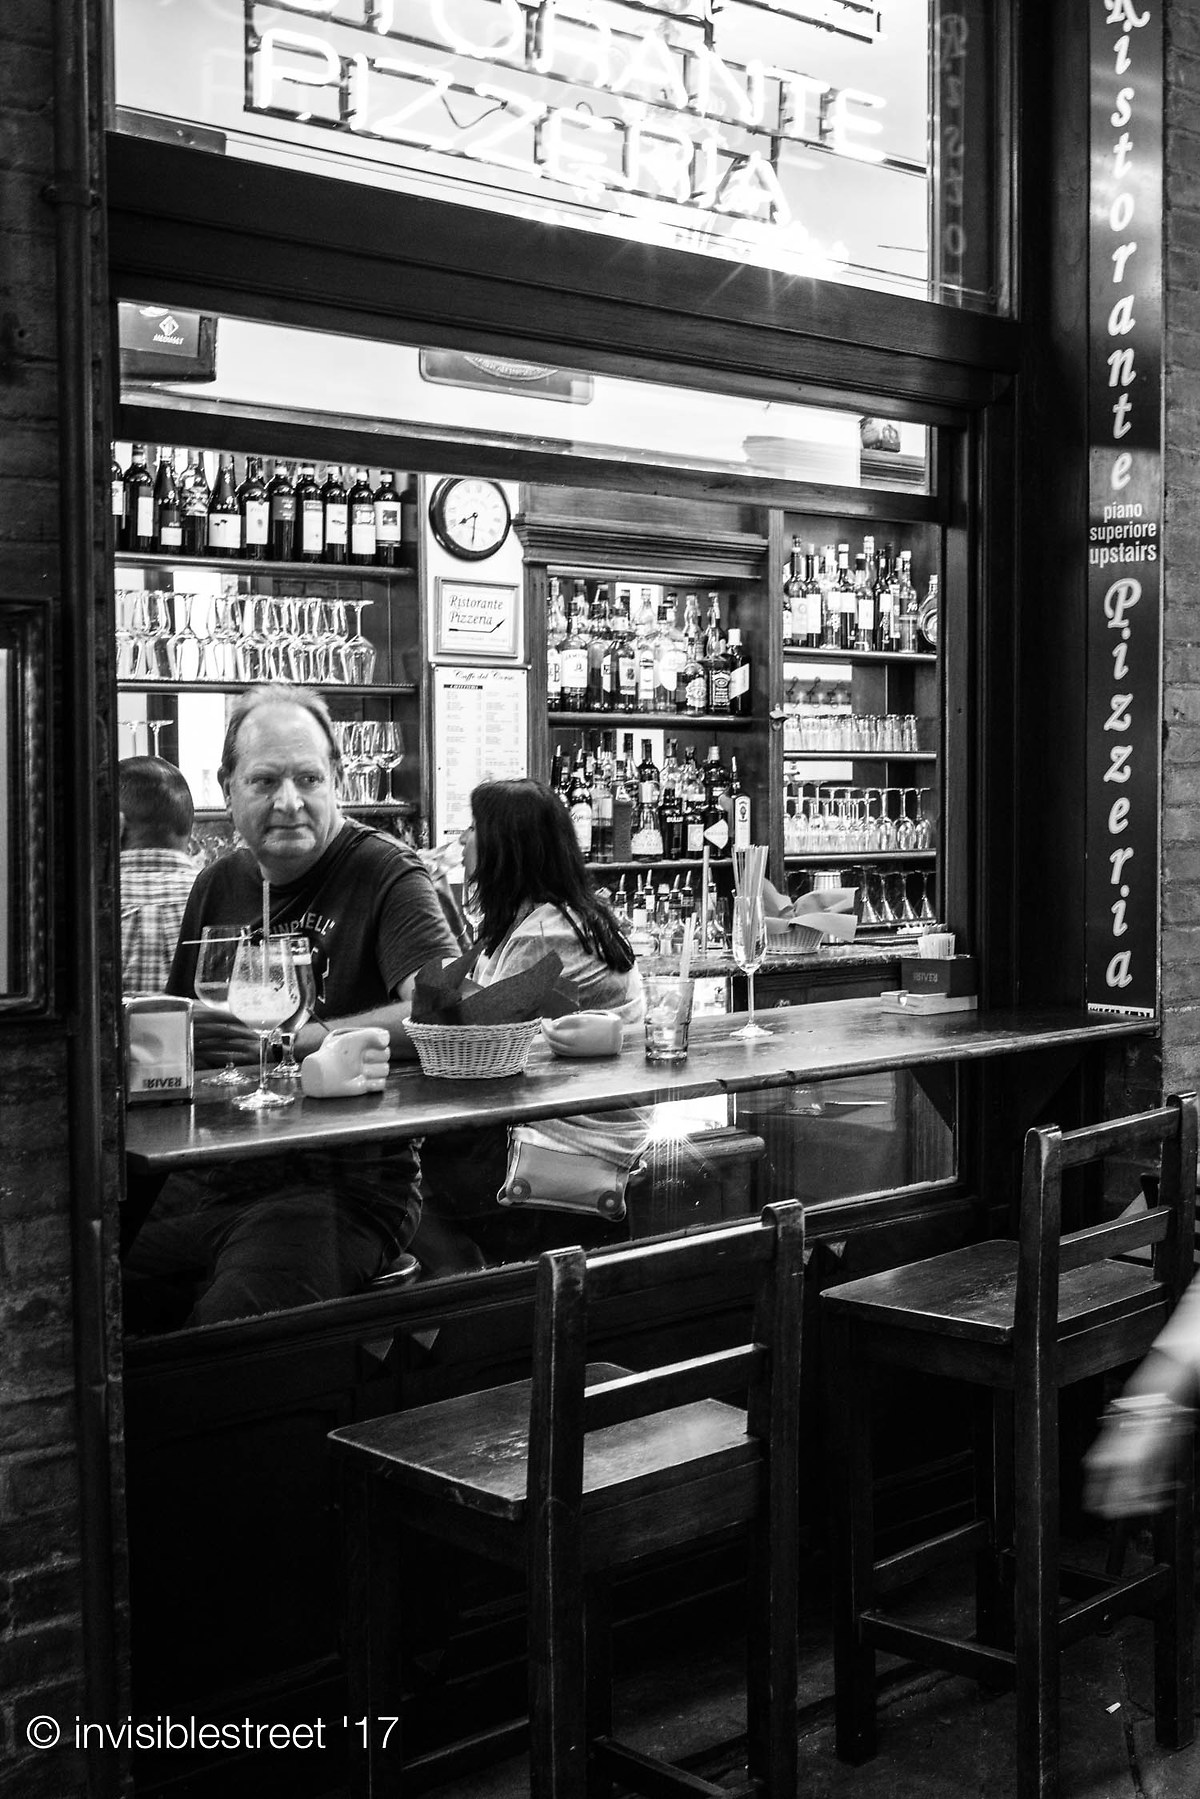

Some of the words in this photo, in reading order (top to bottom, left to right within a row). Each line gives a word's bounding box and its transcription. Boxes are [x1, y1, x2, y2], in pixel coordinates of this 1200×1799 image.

[257, 28, 793, 225] PIZZERIA
[1104, 502, 1142, 521] piano
[1090, 521, 1156, 542] superiore
[1089, 541, 1157, 568] upstairs
[449, 594, 503, 610] Ristorante
[449, 611, 492, 625] Pizzeria
[1103, 578, 1142, 988] Pizzeria
